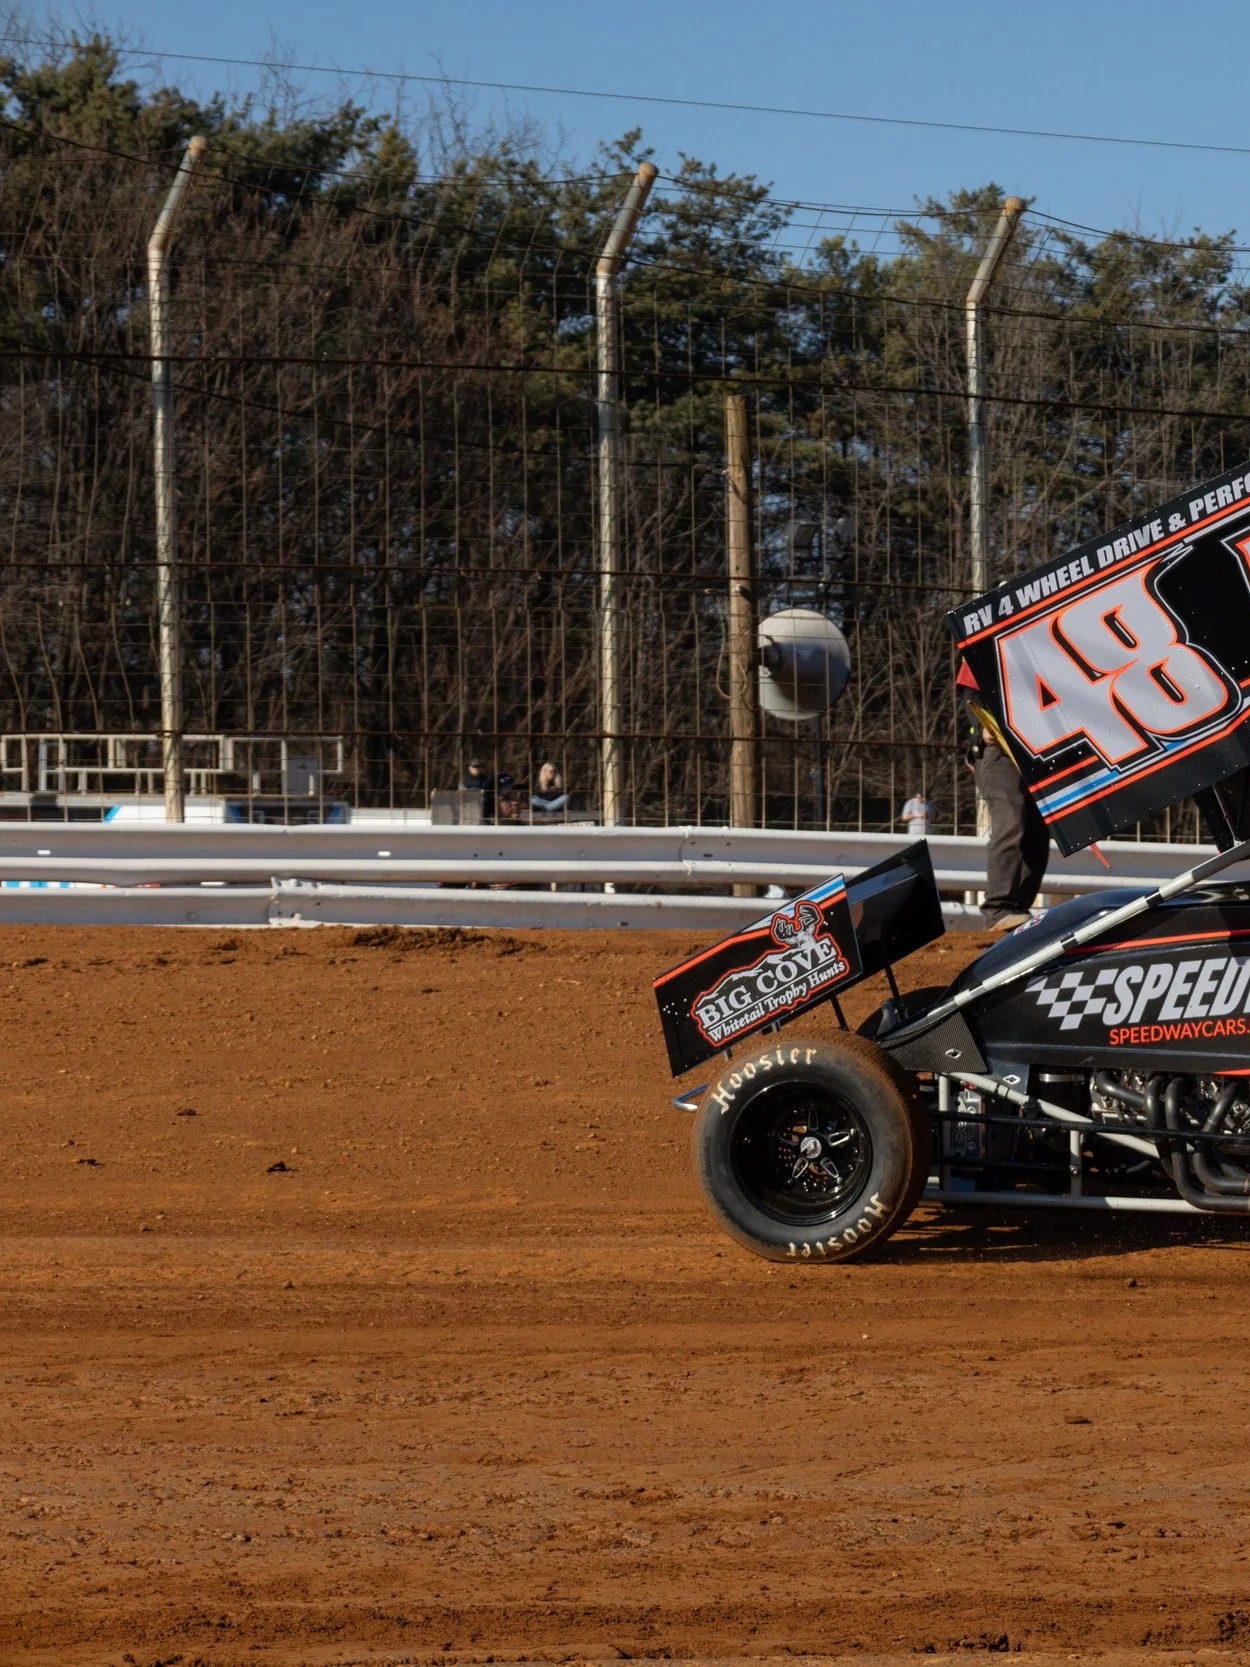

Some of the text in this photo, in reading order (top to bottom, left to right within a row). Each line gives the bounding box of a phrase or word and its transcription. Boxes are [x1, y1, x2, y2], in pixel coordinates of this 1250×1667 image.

[963, 604, 992, 636] RV
[998, 595, 1014, 616] 4
[1016, 556, 1094, 608] WHEEL
[1097, 518, 1164, 568] DRIVE
[1168, 512, 1187, 533] &
[996, 560, 1229, 764] 48
[696, 937, 837, 1029] BIG COVE
[707, 960, 845, 1042] Whitetail Trophy Hunts
[711, 1045, 817, 1114] Hoosier
[787, 1192, 892, 1258] Hoosier
